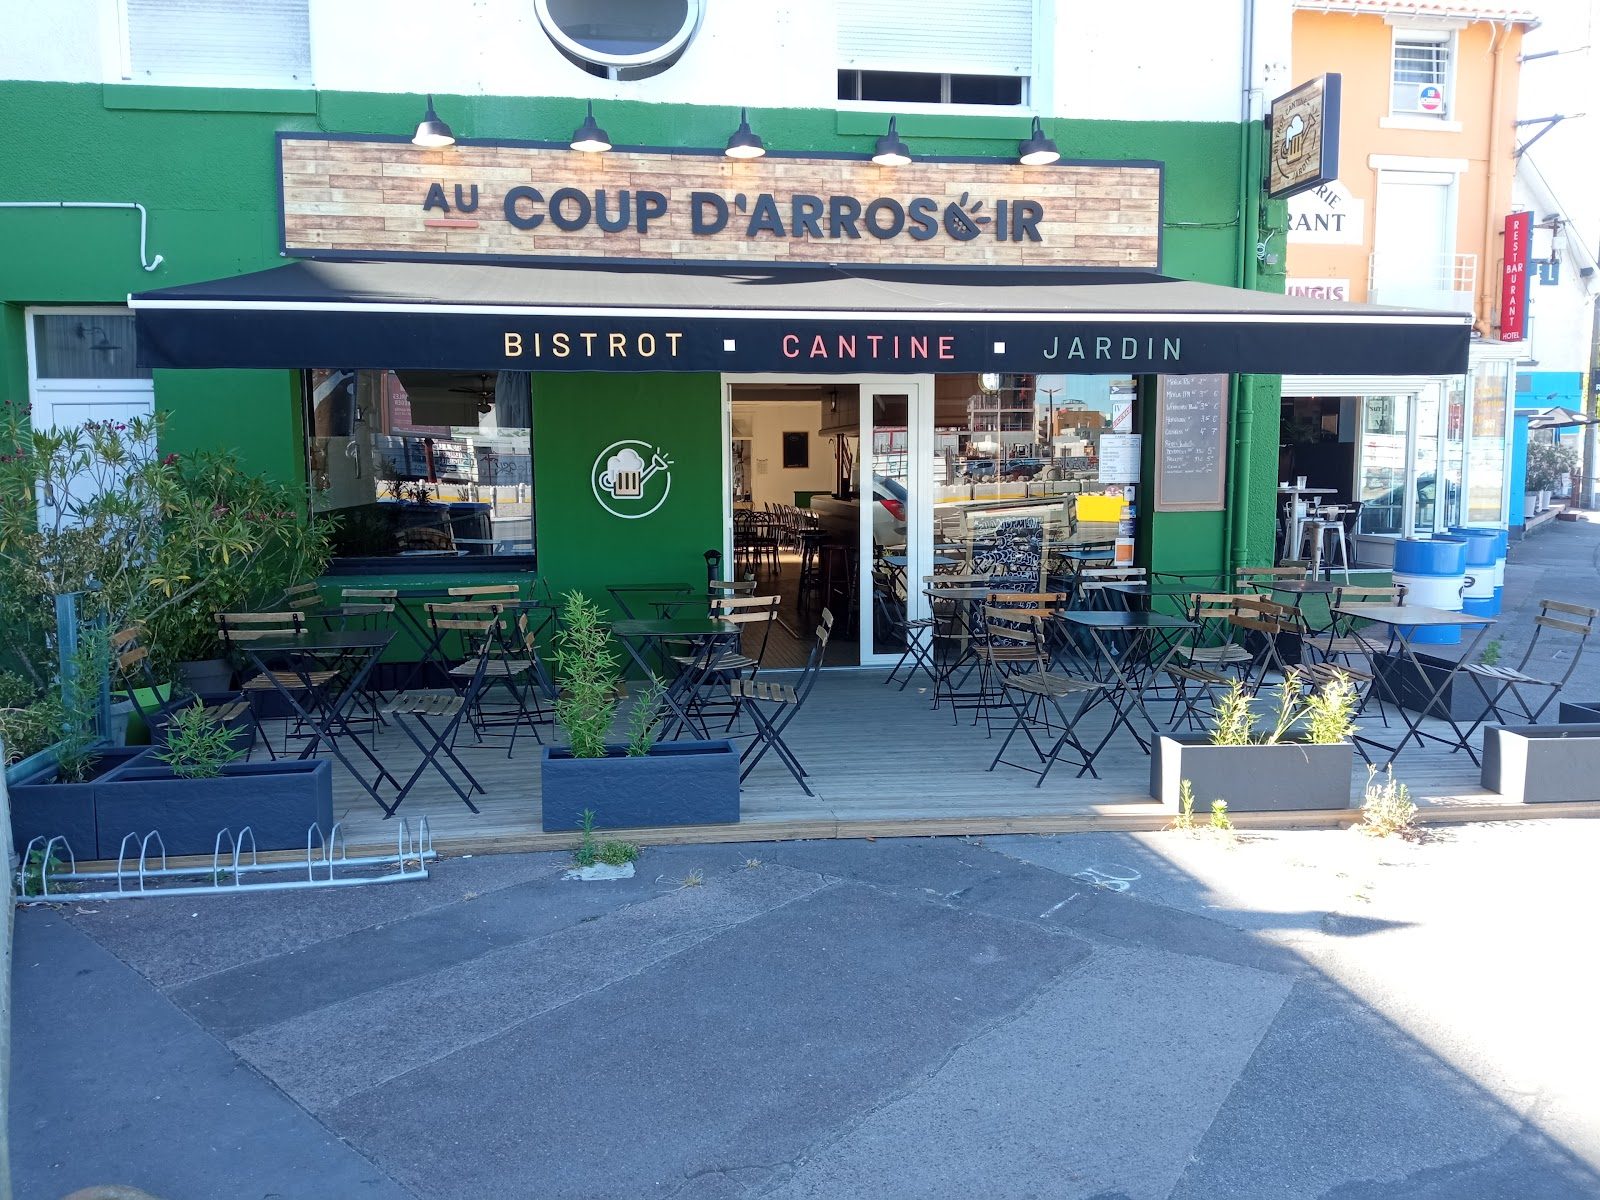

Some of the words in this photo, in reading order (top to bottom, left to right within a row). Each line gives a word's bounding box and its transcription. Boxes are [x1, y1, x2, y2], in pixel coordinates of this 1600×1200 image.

[423, 182, 479, 213] AU
[503, 185, 668, 234] COUP
[1506, 263, 1524, 274] BAR
[1509, 220, 1520, 326] RESTAURANT
[504, 332, 684, 358] BISTROT
[782, 334, 955, 360] CANTINE
[1043, 336, 1181, 361] JARDIN
[1502, 331, 1520, 340] HOTEL
